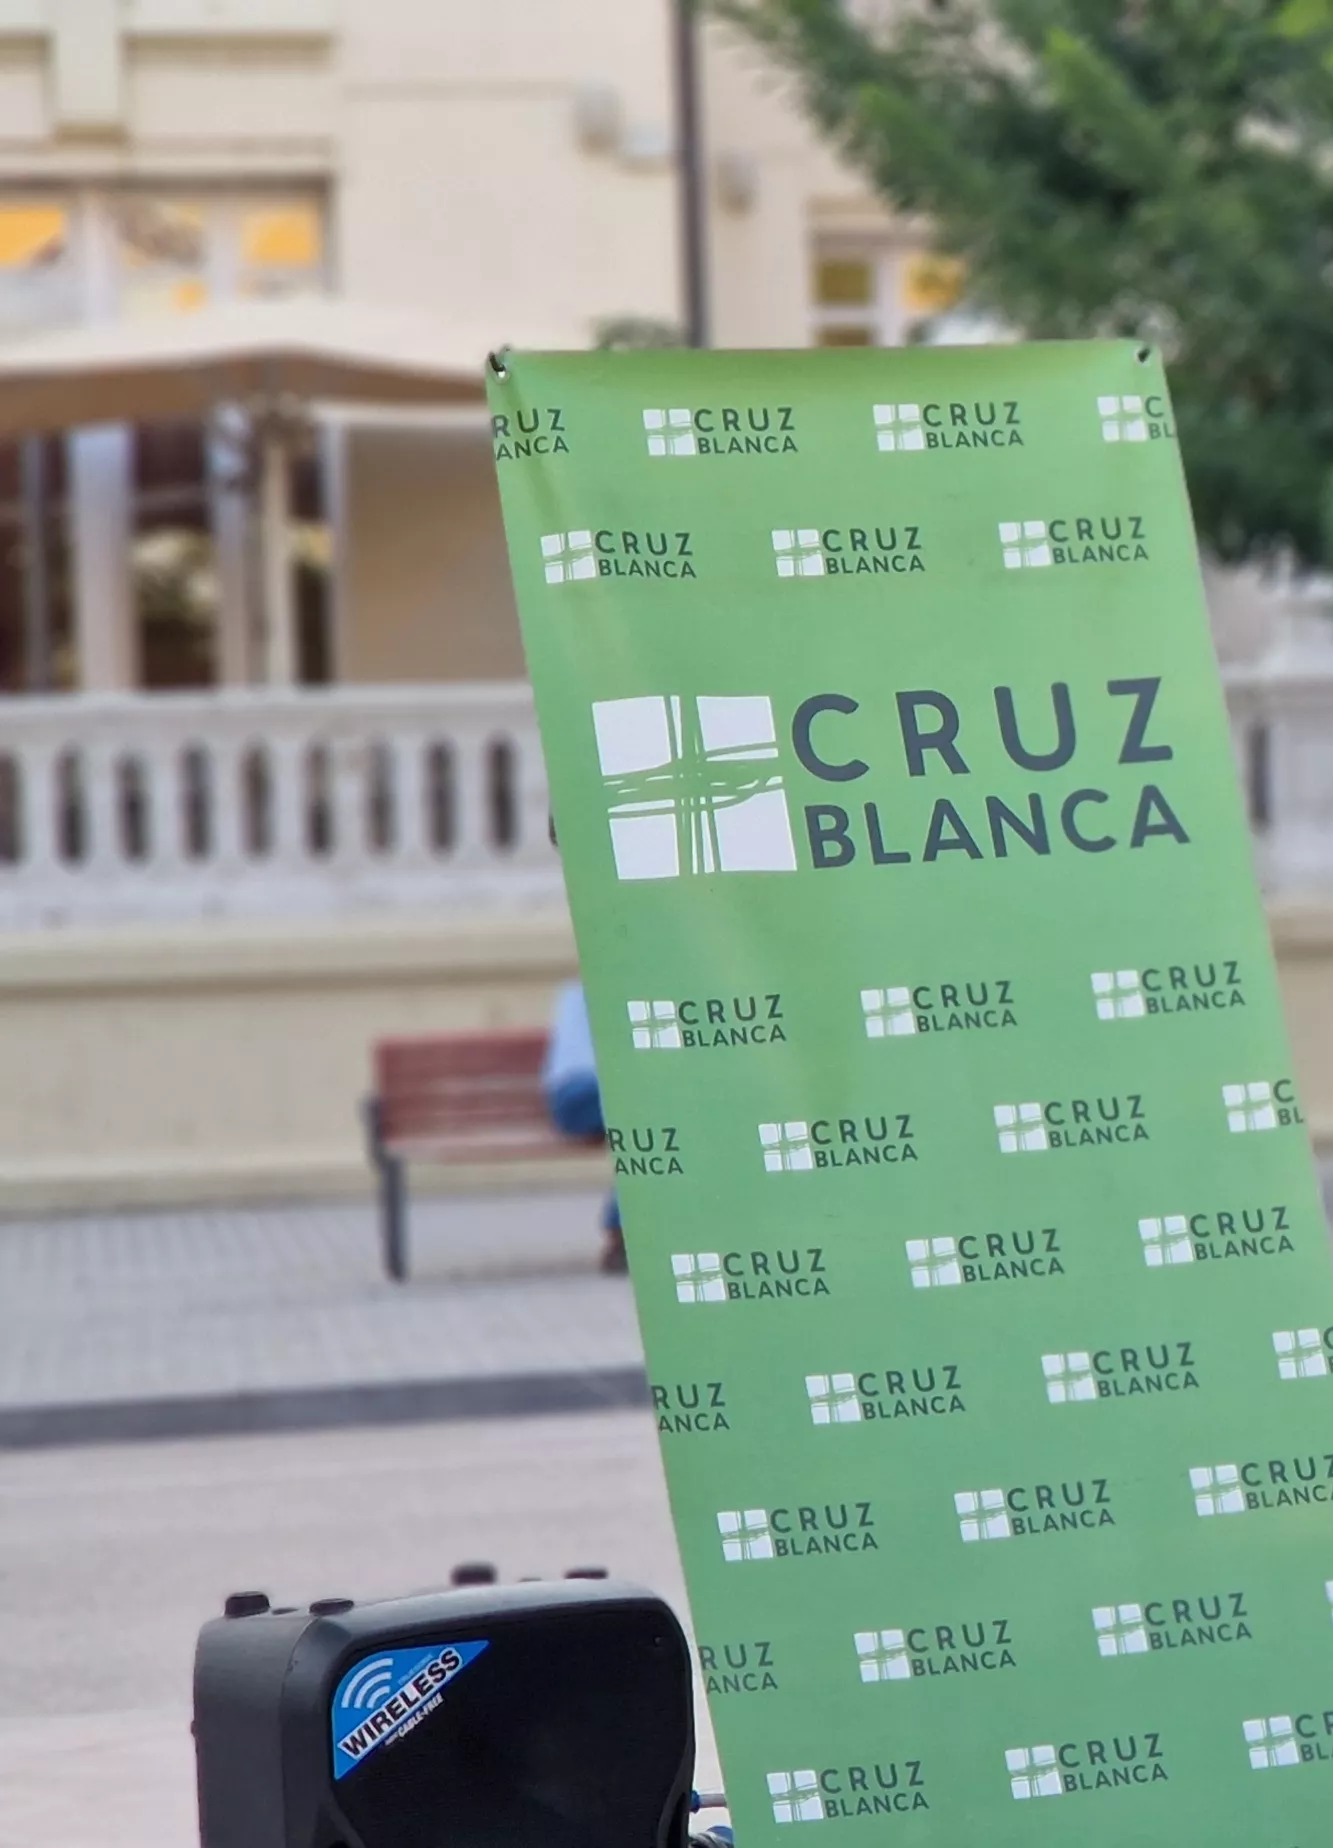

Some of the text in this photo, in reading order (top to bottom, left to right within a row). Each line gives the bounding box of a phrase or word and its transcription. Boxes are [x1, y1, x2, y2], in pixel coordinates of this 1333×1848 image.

[693, 406, 795, 433] CRUZ
[922, 401, 1021, 428] CRUZ
[696, 435, 799, 455] BLANCA
[925, 428, 1025, 450] BLANCA
[594, 529, 694, 557] CRUZ
[821, 526, 922, 553] CRUZ
[1048, 515, 1146, 544] CRUZ
[597, 558, 697, 579] BLANCA
[824, 554, 926, 575] BLANCA
[1051, 543, 1149, 565] BLANCA
[791, 675, 1174, 783] CRUZ
[803, 784, 1192, 870] BLANCA
[1141, 960, 1242, 993] CRUZ
[678, 993, 784, 1026] CRUZ
[912, 980, 1015, 1011] CRUZ
[1145, 989, 1246, 1015] BLANCA
[915, 1008, 1018, 1033] BLANCA
[681, 1023, 787, 1048] BLANCA
[1043, 1094, 1146, 1126] CRUZ
[810, 1113, 915, 1146] CRUZ
[1048, 1123, 1150, 1149] BLANCA
[813, 1142, 919, 1169] BLANCA
[1189, 1205, 1290, 1239] CRUZ
[957, 1227, 1061, 1260] CRUZ
[1193, 1234, 1295, 1261] BLANCA
[722, 1248, 826, 1278] CRUZ
[961, 1256, 1065, 1283] BLANCA
[726, 1277, 831, 1300] BLANCA
[1092, 1341, 1195, 1376] CRUZ
[857, 1364, 962, 1398] CRUZ
[1096, 1370, 1200, 1398] BLANCA
[861, 1394, 966, 1421] BLANCA
[1006, 1478, 1111, 1513] CRUZ
[770, 1501, 875, 1534] CRUZ
[1010, 1508, 1116, 1536] BLANCA
[774, 1531, 879, 1557] BLANCA
[1144, 1592, 1248, 1627] CRUZ
[906, 1619, 1012, 1654] CRUZ
[1148, 1621, 1253, 1651] BLANCA
[911, 1648, 1017, 1677] BLANCA
[341, 1649, 461, 1757] WIRELESS
[1058, 1732, 1164, 1769] CRUZ
[819, 1760, 925, 1795] CRUZ
[1062, 1763, 1169, 1793] BLANCA
[824, 1791, 930, 1819] BLANCA
